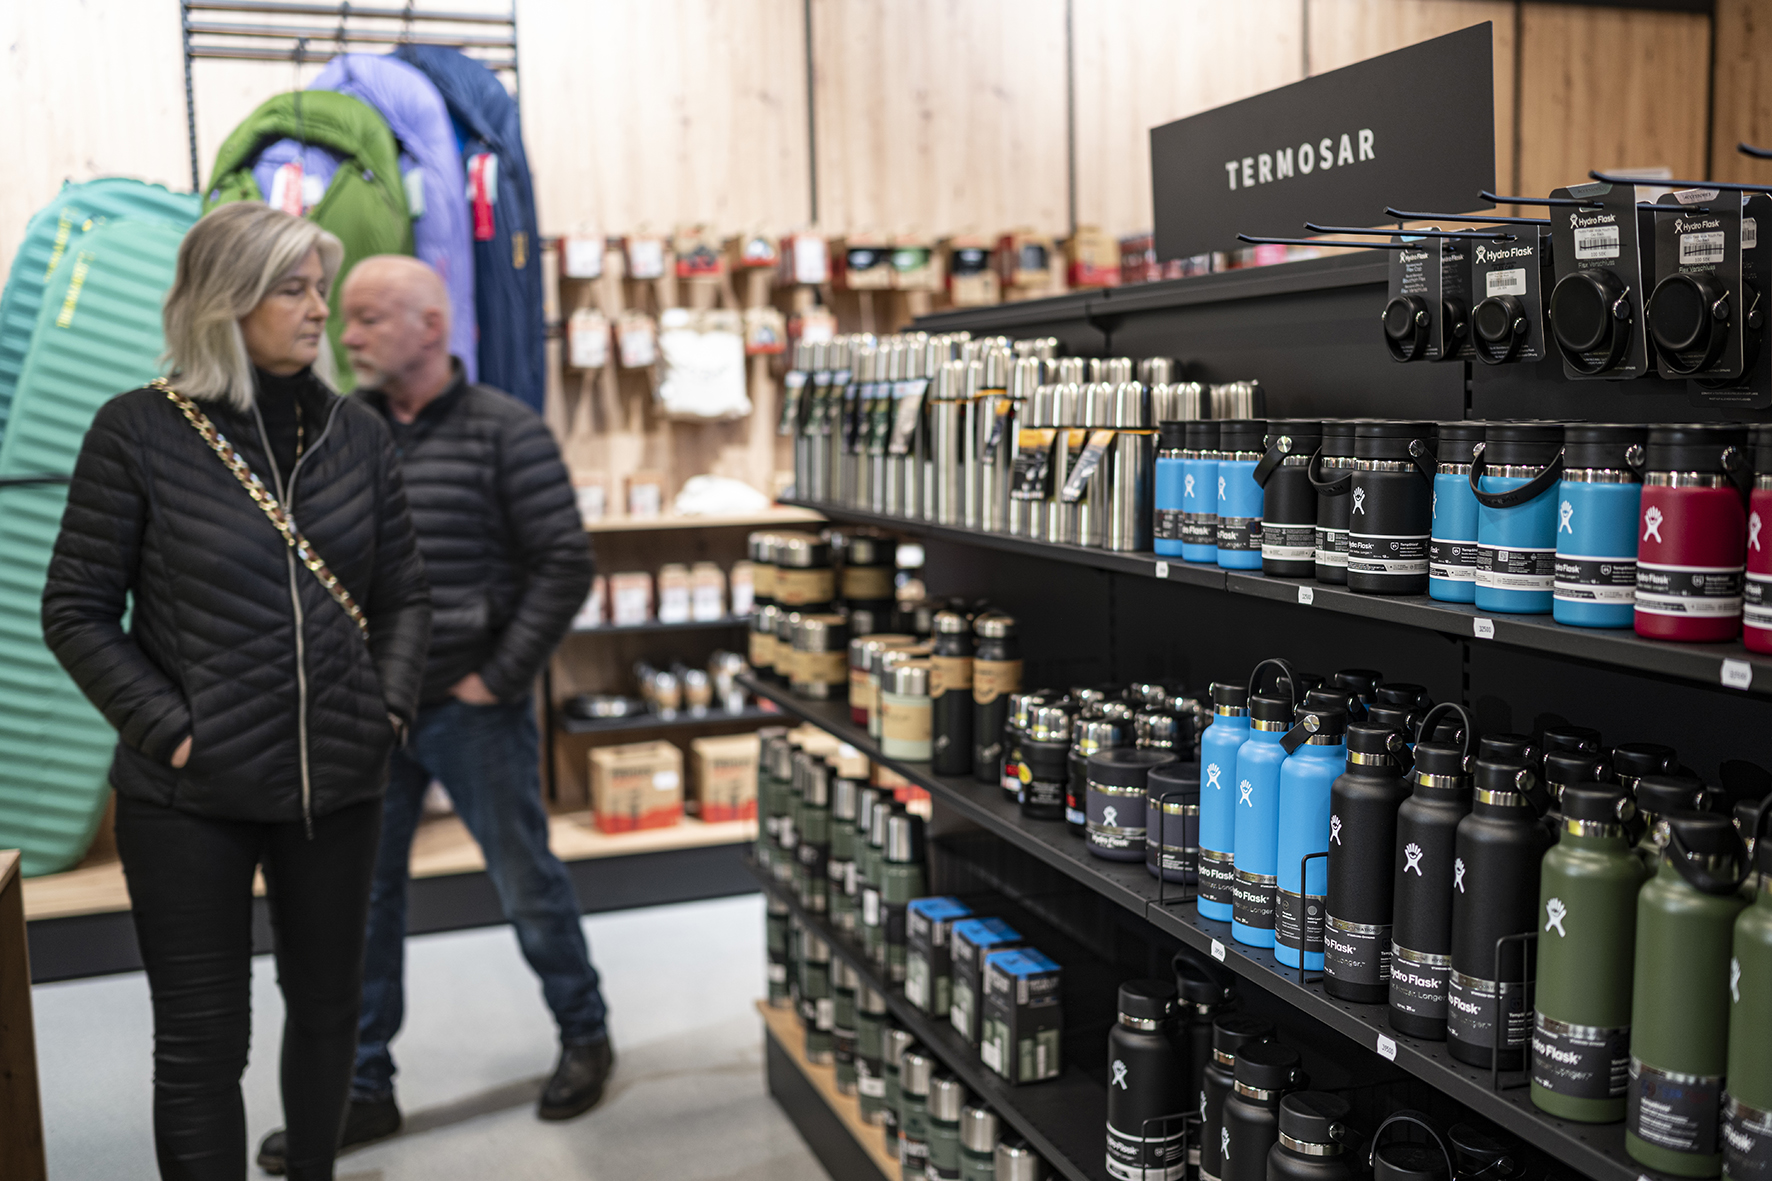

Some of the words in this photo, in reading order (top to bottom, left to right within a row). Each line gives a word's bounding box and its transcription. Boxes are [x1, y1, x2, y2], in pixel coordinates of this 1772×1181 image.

[1225, 128, 1375, 191] TERMOSAR
[1579, 217, 1597, 227] Hydro
[1597, 213, 1616, 222] Flask
[1683, 222, 1701, 232] Hydro
[1702, 219, 1720, 229] Flask
[1487, 249, 1510, 262] Hydro
[1511, 246, 1533, 256] Flask
[1358, 541, 1373, 549] Flask
[1211, 869, 1234, 880] Flask
[1243, 891, 1267, 904] Flask
[1331, 939, 1354, 955] Flask
[1408, 973, 1439, 989] Flask
[1453, 995, 1479, 1016] Flask
[1546, 1044, 1579, 1066] Flask
